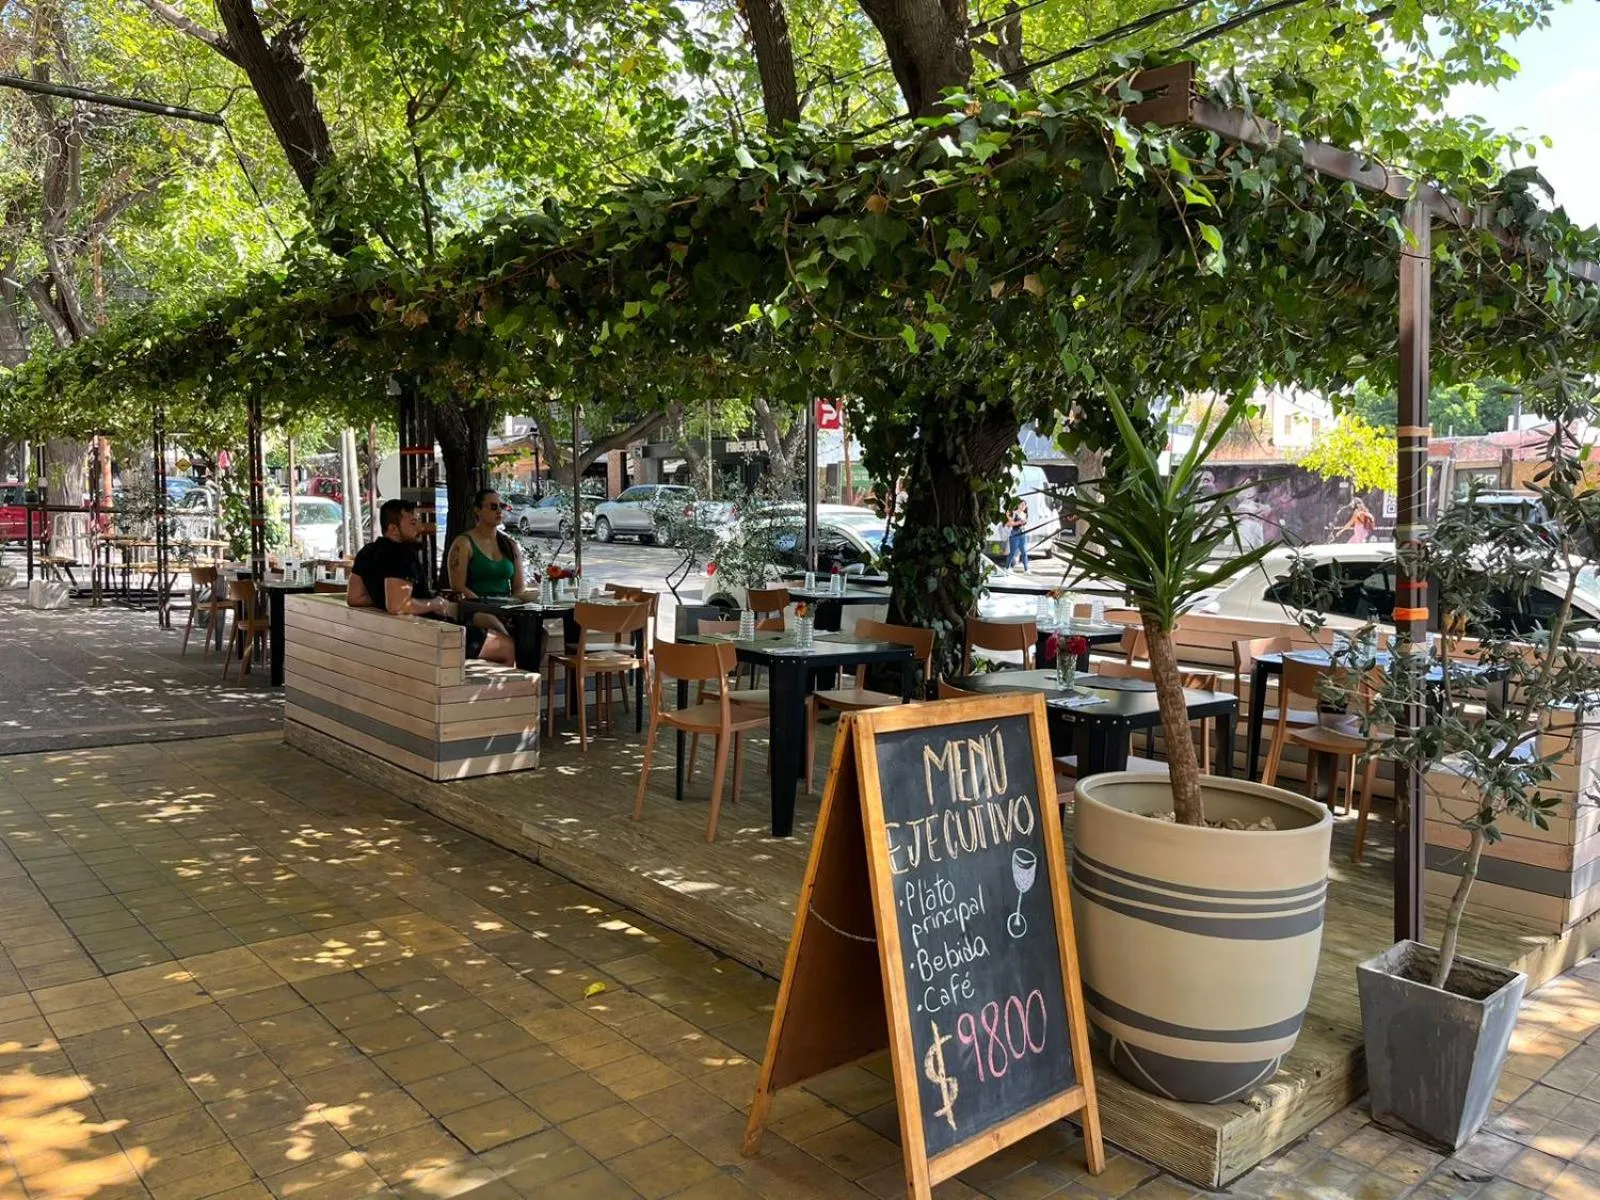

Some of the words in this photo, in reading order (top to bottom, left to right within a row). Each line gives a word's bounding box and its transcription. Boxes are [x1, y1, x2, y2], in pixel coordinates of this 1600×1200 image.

[923, 724, 1008, 806] MENÚ
[885, 794, 1035, 875] EJECUTIVO
[912, 883, 986, 949] principal
[917, 935, 990, 982] Bebida
